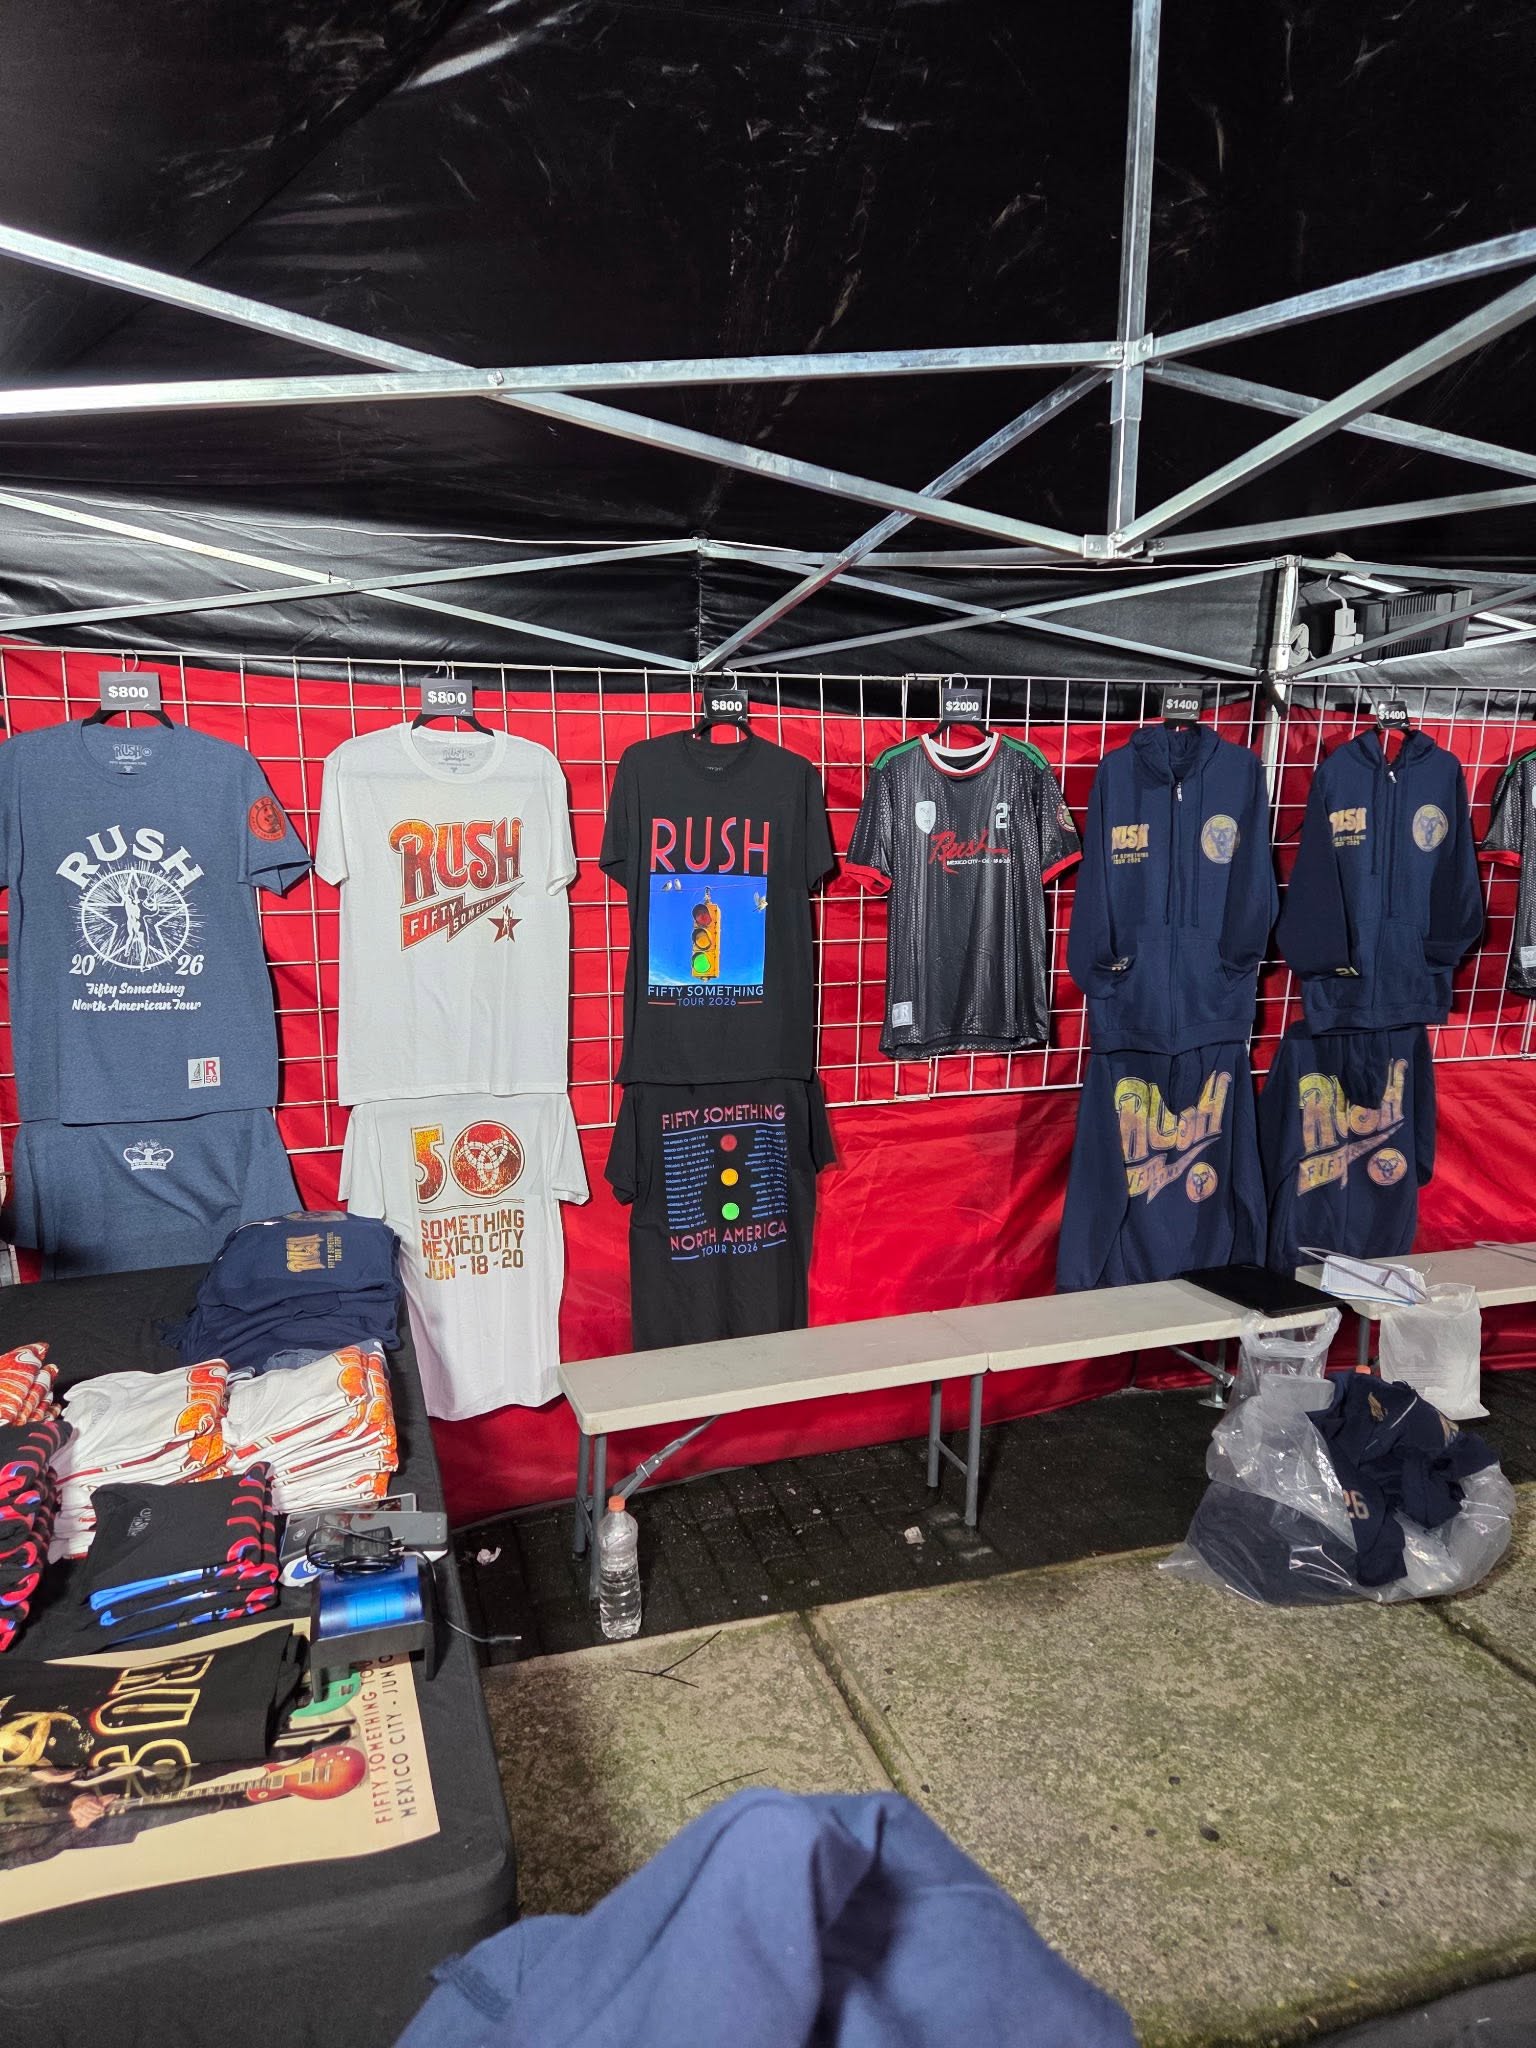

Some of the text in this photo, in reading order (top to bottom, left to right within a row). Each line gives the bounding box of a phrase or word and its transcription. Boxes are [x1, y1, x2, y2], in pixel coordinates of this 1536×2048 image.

[108, 685, 149, 698] $800
[427, 690, 467, 705] $800
[711, 699, 743, 712] $800
[944, 700, 979, 713] $2000
[1165, 698, 1199, 711] $1400
[1378, 710, 1406, 720] $1400
[113, 743, 142, 760] RUSH
[650, 816, 770, 875] RUSH
[928, 825, 1009, 876] Rush
[56, 824, 204, 891] RUSH
[388, 816, 524, 909] RUSH
[410, 901, 457, 937] FIFTY
[69, 953, 205, 976] 20 26
[86, 982, 185, 997] Fifty Something
[647, 985, 764, 997] FIFTY SOMETHING
[72, 998, 202, 1012] North American Tour
[676, 996, 737, 1007] TOUR 2026
[205, 1060, 217, 1076] R
[206, 1075, 218, 1084] 50
[661, 1103, 786, 1130] FIFTY SOMETHING
[420, 1208, 525, 1240] SOMETHING
[421, 1228, 525, 1261] MEXICO CITY
[670, 1220, 788, 1252] NORTH AMERICA
[701, 1242, 759, 1258] TOUR 2026
[424, 1258, 456, 1281] JUN
[470, 1254, 489, 1275] 18
[501, 1248, 524, 1269] 20
[362, 1690, 387, 1773] SOMETHING
[386, 1711, 406, 1745] CITY
[391, 1752, 417, 1819] MEXICO
[371, 1781, 393, 1825] FIFTY
